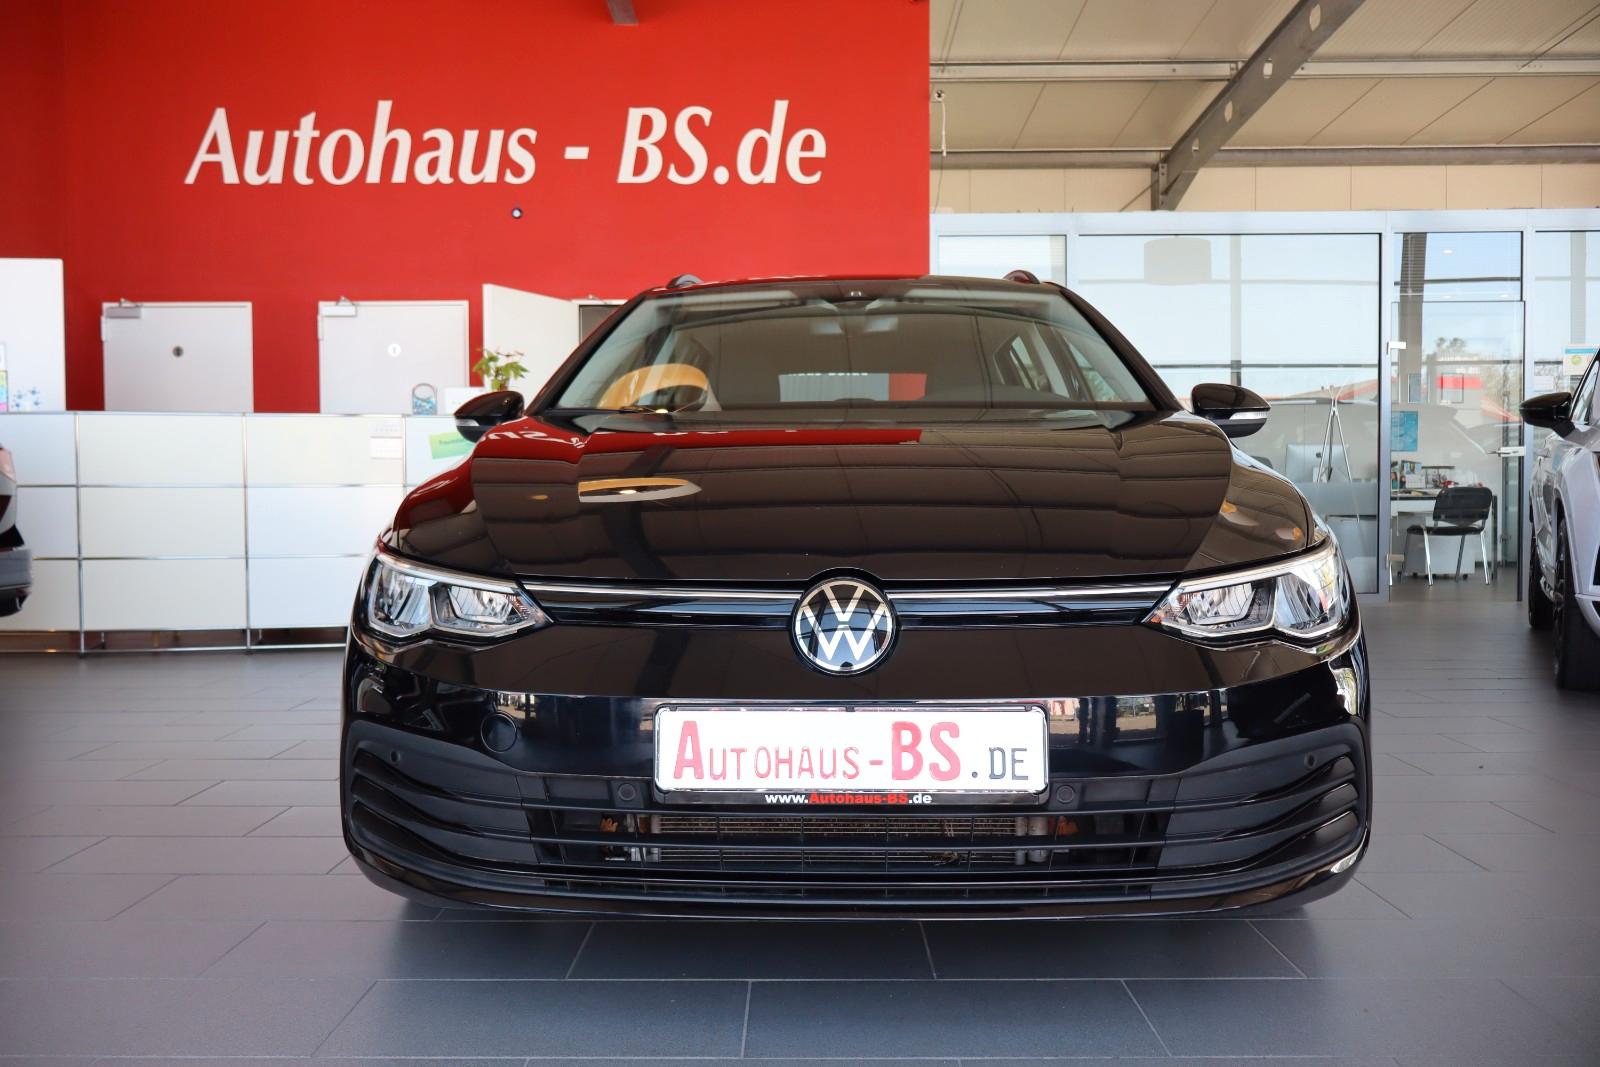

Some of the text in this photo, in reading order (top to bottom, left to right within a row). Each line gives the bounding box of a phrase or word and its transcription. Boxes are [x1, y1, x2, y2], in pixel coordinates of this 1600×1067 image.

[185, 100, 537, 186] Autohaus
[617, 99, 827, 185] BS.de
[797, 580, 891, 669] VW
[765, 791, 932, 805] www.Autohaus-BS.de
